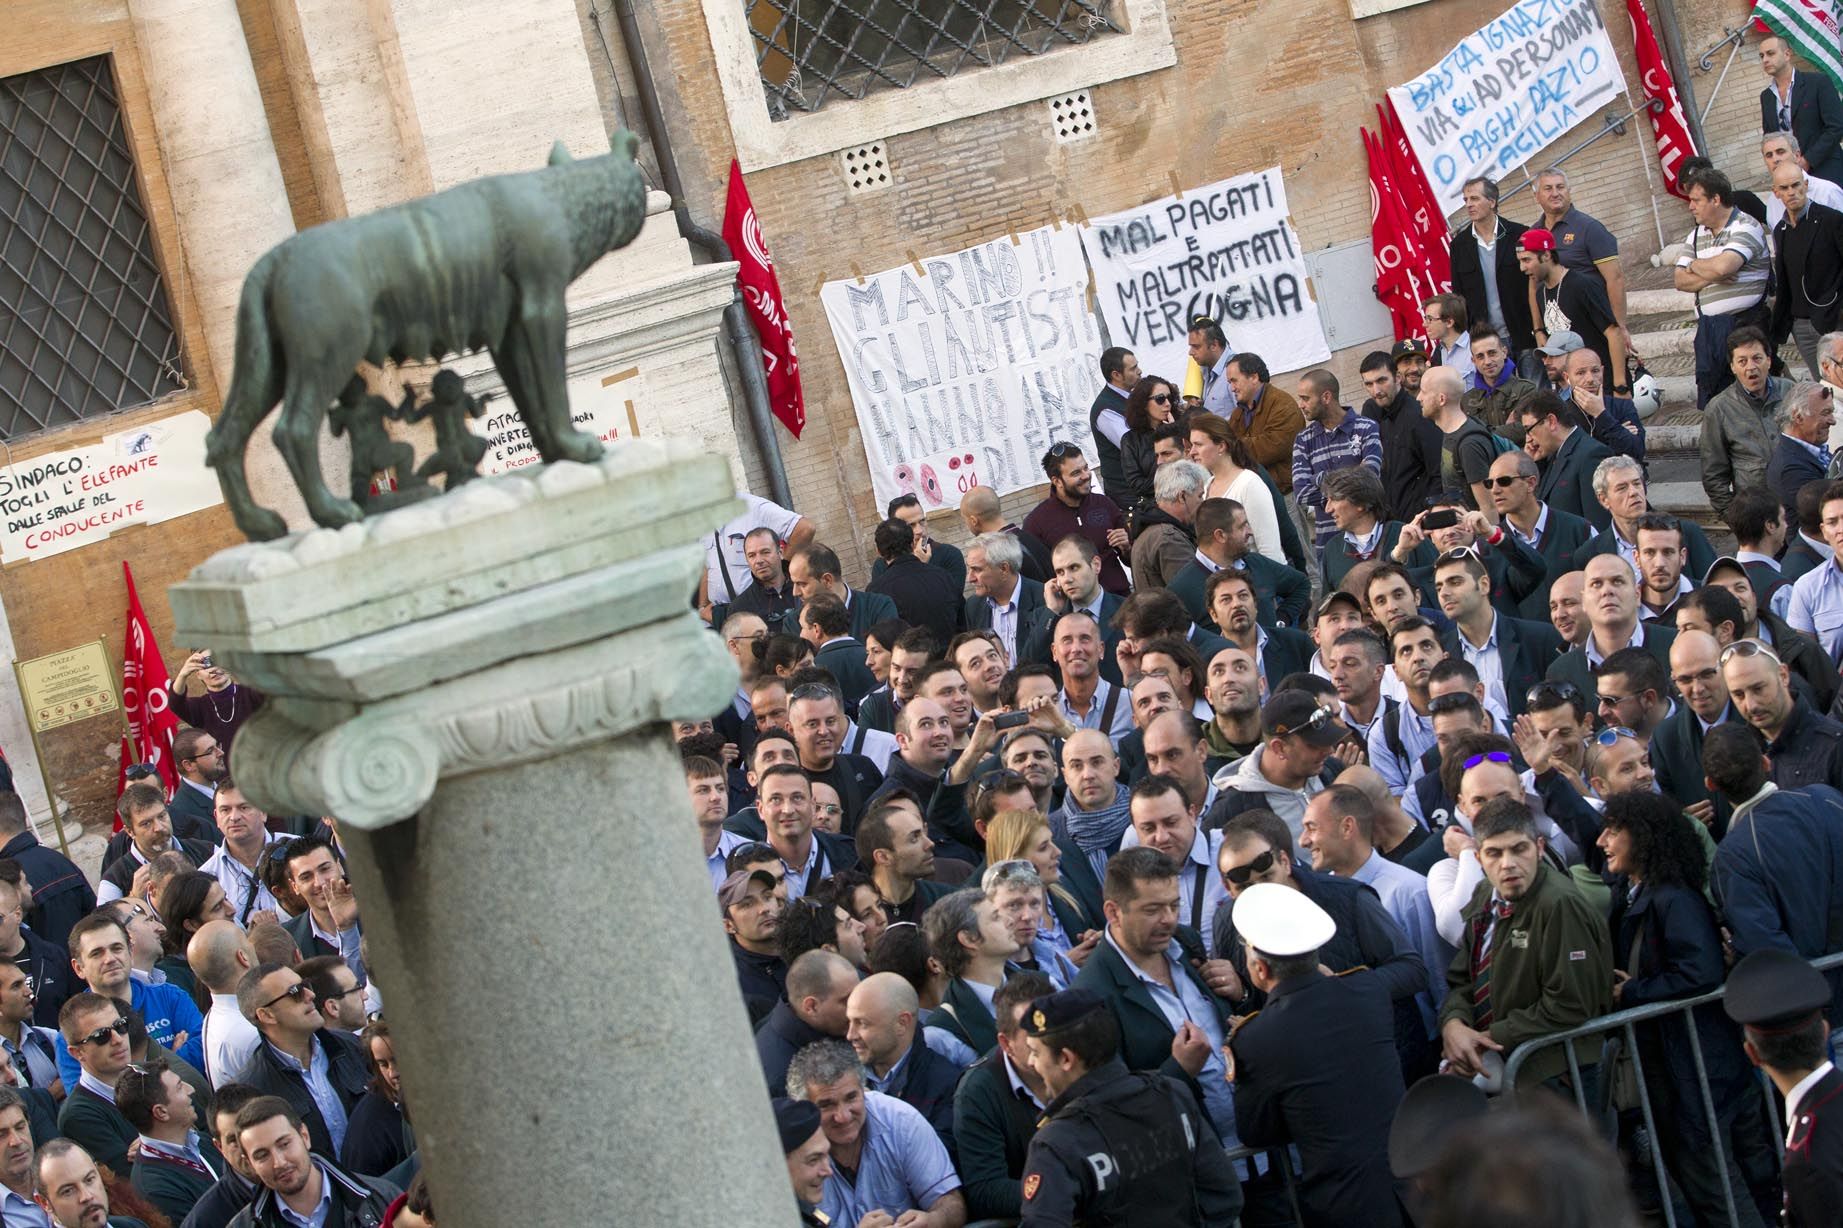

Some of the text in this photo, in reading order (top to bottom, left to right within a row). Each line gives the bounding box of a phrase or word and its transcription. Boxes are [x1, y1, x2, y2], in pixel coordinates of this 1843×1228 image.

[1405, 42, 1485, 112] BASTA
[1417, 105, 1461, 147] VIA
[1472, 73, 1502, 109] AD
[1433, 46, 1600, 185] O PAGHI DAZIO
[1099, 174, 1274, 259] MAL PAGATI
[1185, 235, 1200, 253] E
[845, 242, 1023, 332] MARINO
[1116, 219, 1295, 313] MALTRATTATI
[870, 375, 1009, 466] HANNO
[0, 490, 50, 516] TOGLI
[80, 455, 159, 491] ELEFANTE
[8, 492, 117, 534] DALLE SPALLE DEL
[25, 499, 146, 550] CONDUCENTE
